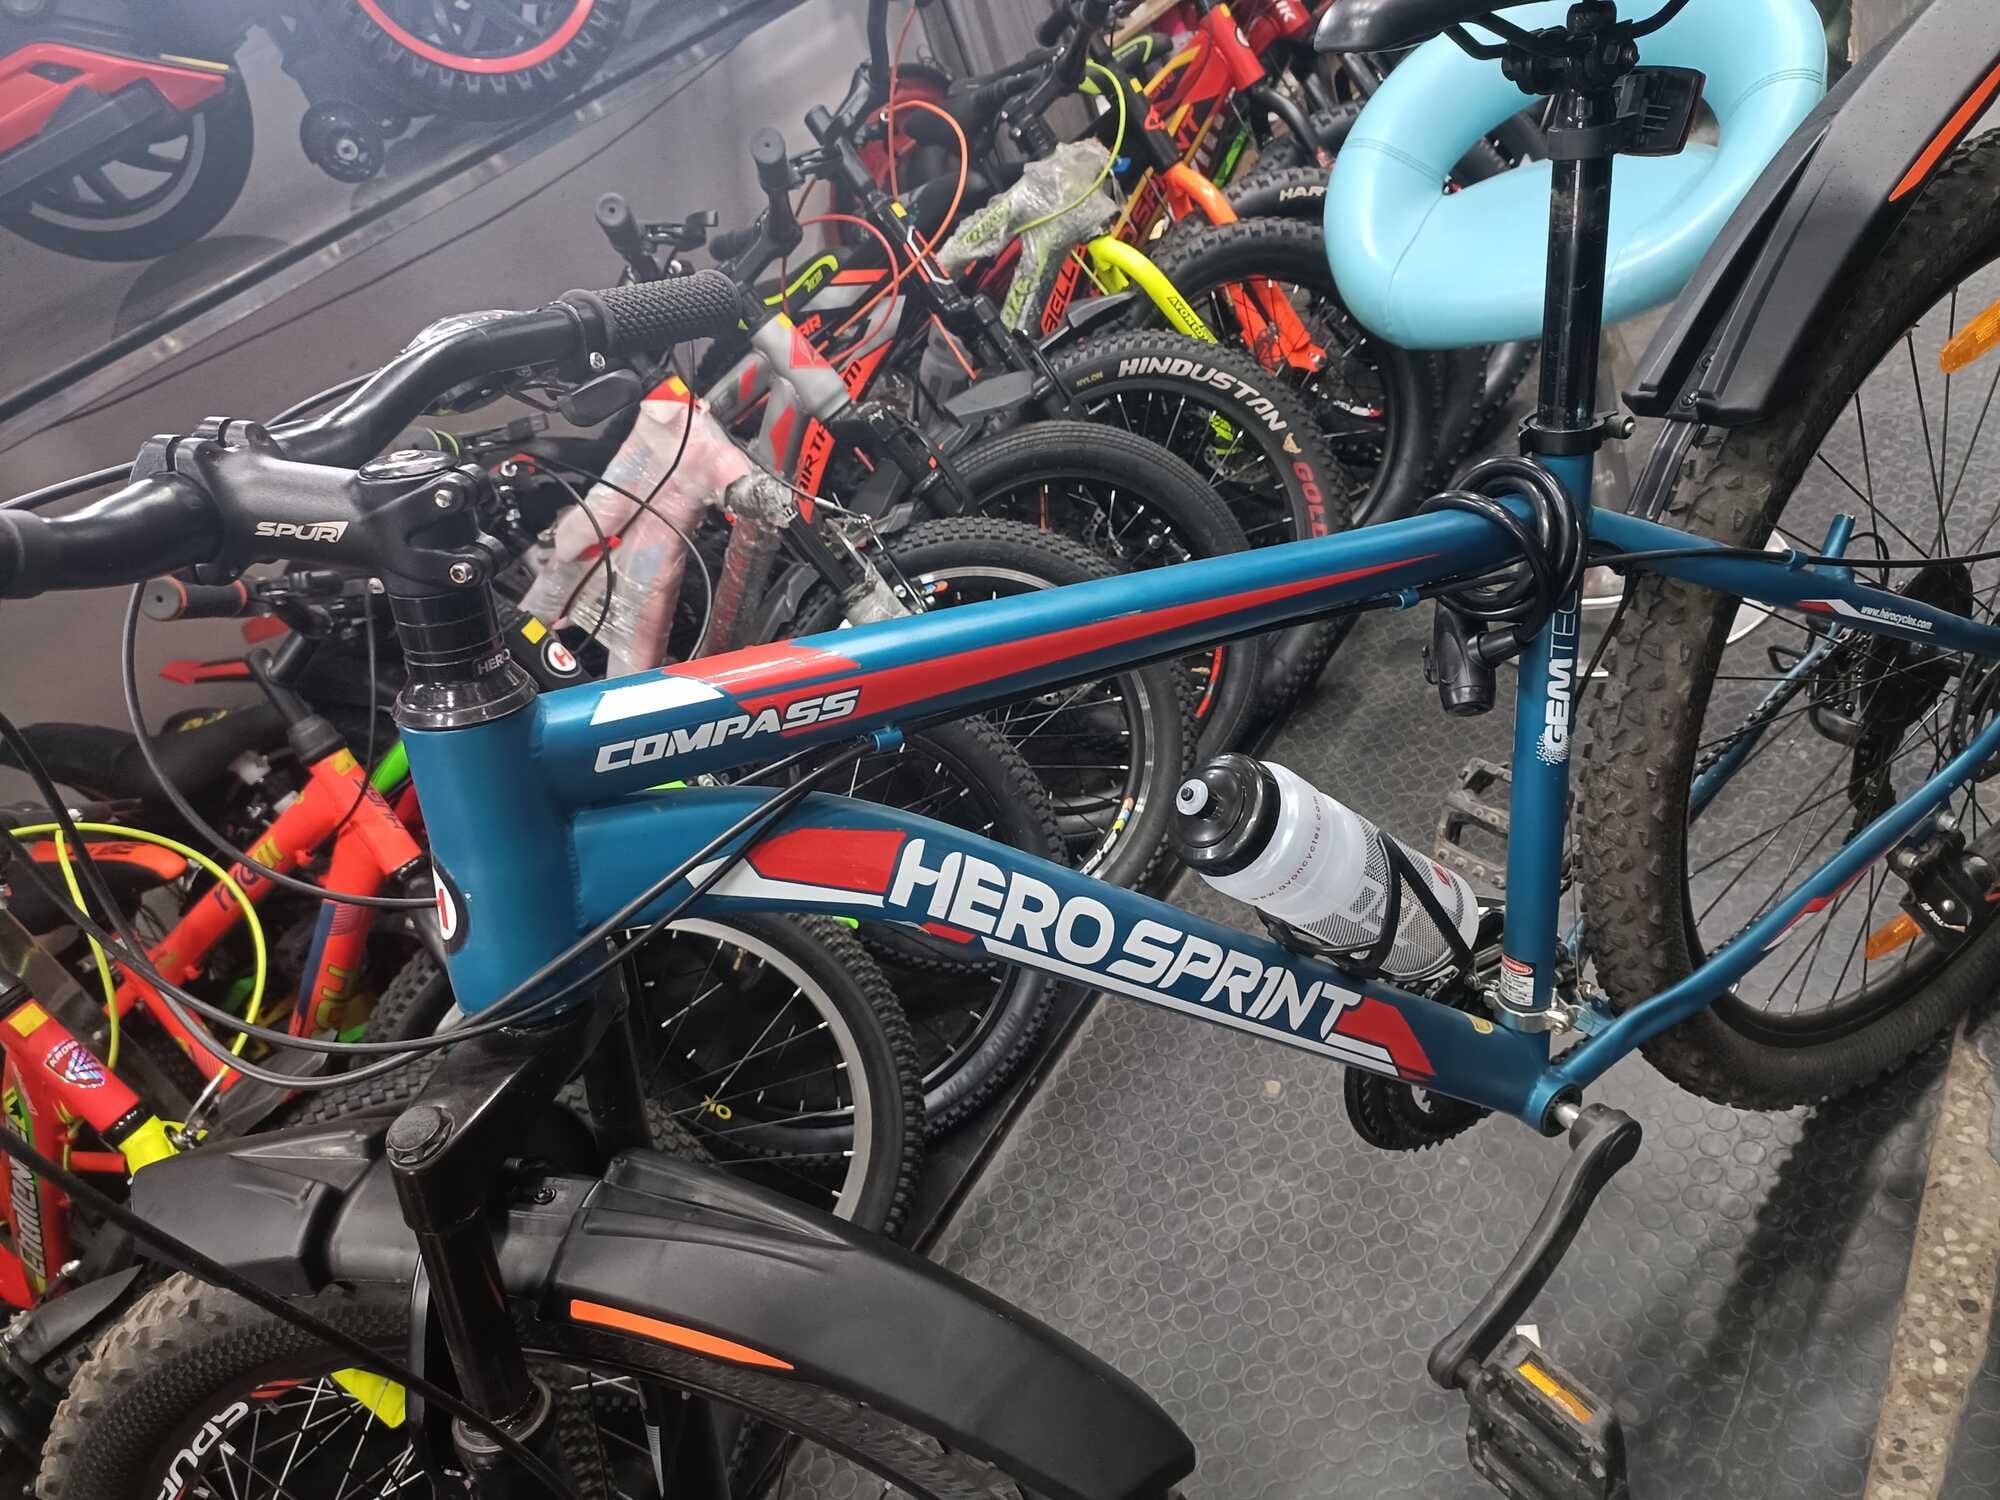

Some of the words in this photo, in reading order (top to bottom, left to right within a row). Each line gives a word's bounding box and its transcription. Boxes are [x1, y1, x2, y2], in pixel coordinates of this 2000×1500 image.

[1118, 357, 1288, 433] HINDUSTAN
[254, 520, 349, 543] SPUR
[1860, 605, 1933, 630] www.herocycles.com
[477, 648, 511, 675] HERO
[594, 688, 861, 773] COMPASS
[889, 838, 1115, 965] HERO
